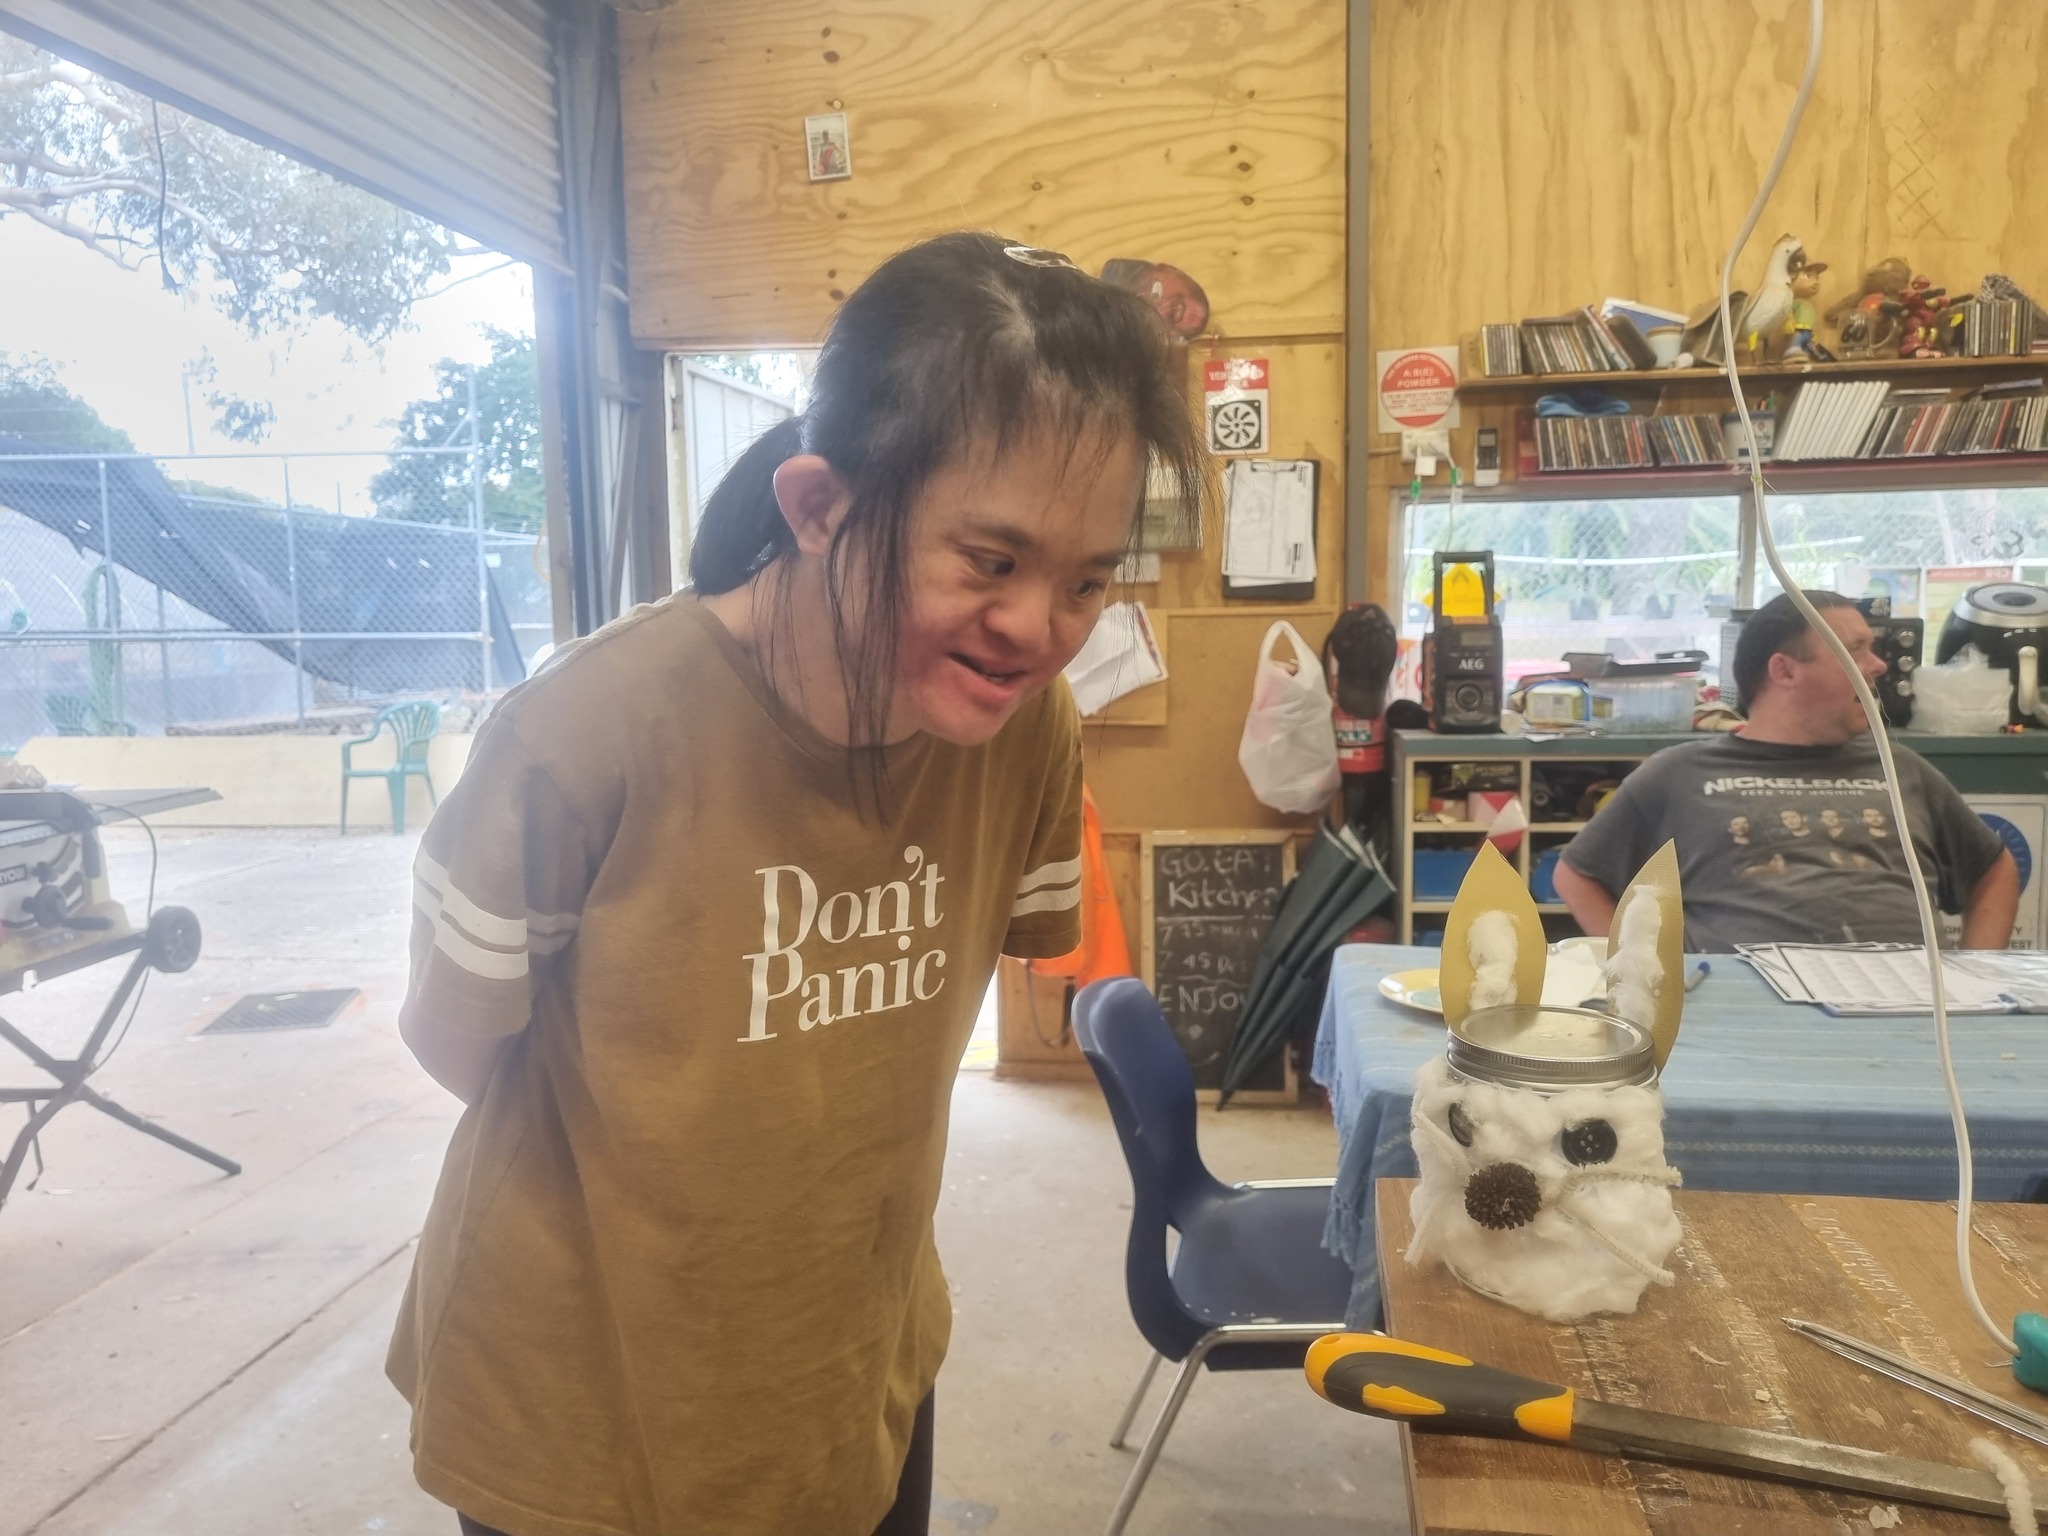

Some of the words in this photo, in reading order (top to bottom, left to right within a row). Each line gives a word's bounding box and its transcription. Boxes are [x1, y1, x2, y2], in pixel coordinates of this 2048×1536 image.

[1396, 376, 1441, 389] POWDER
[1458, 658, 1485, 671] AEG
[1703, 776, 1889, 797] NICKELBACK
[1779, 789, 1804, 797] THE
[736, 935, 947, 1043] Panic
